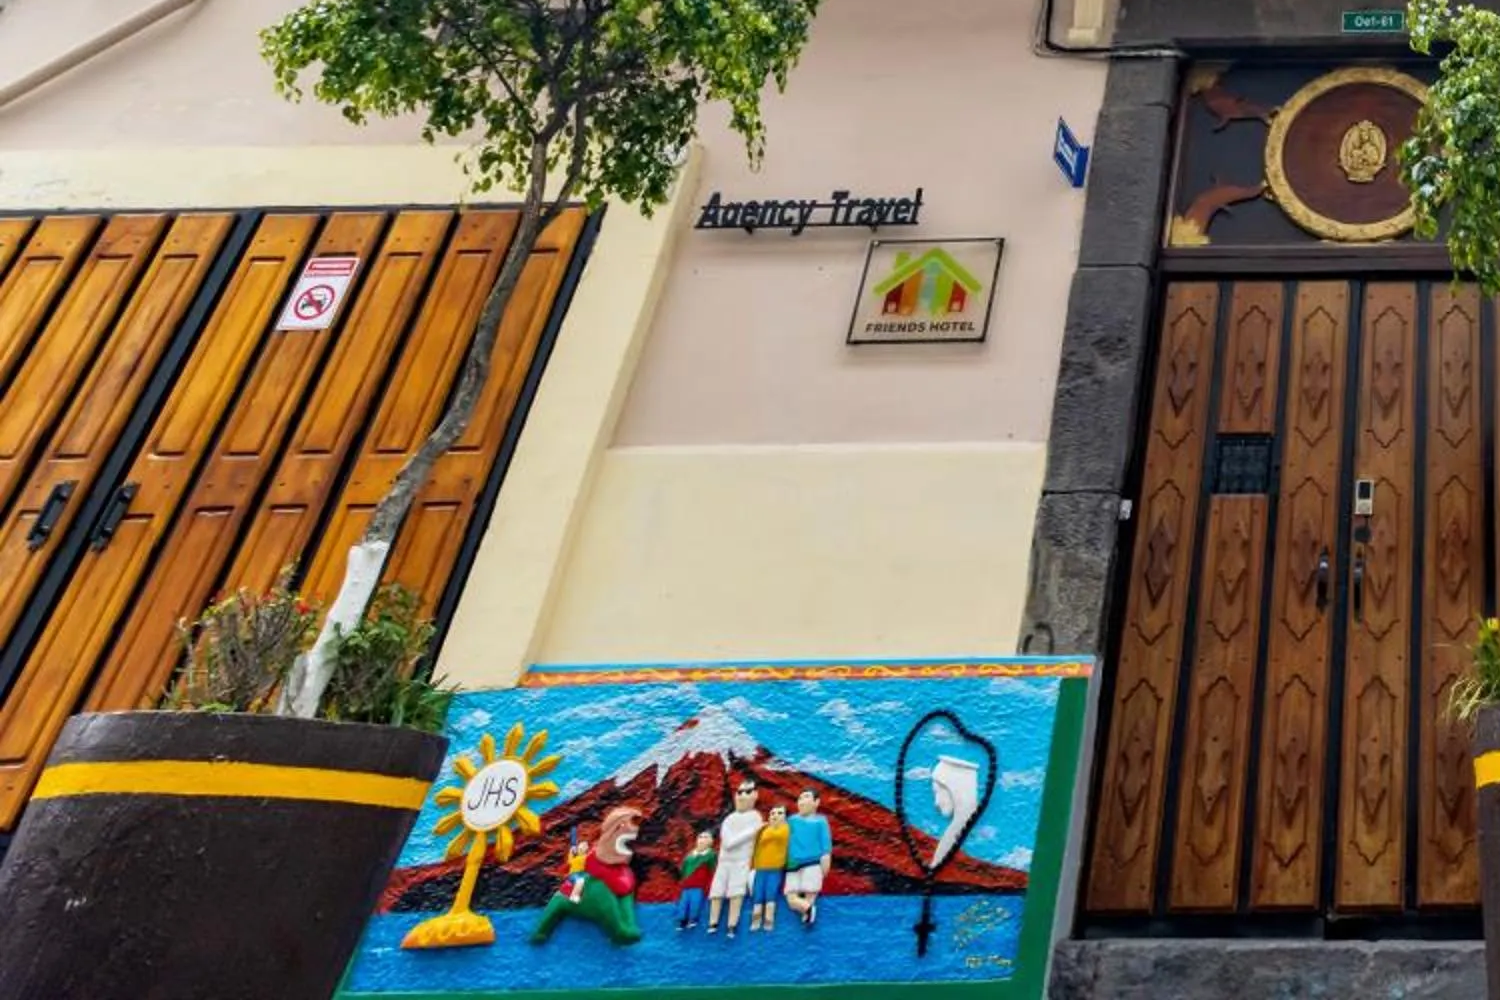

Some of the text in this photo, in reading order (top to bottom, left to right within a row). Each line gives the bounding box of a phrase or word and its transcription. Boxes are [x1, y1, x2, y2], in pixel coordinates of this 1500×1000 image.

[698, 187, 924, 237] Agency Travel
[865, 320, 976, 333] FRIENDS HOTEL
